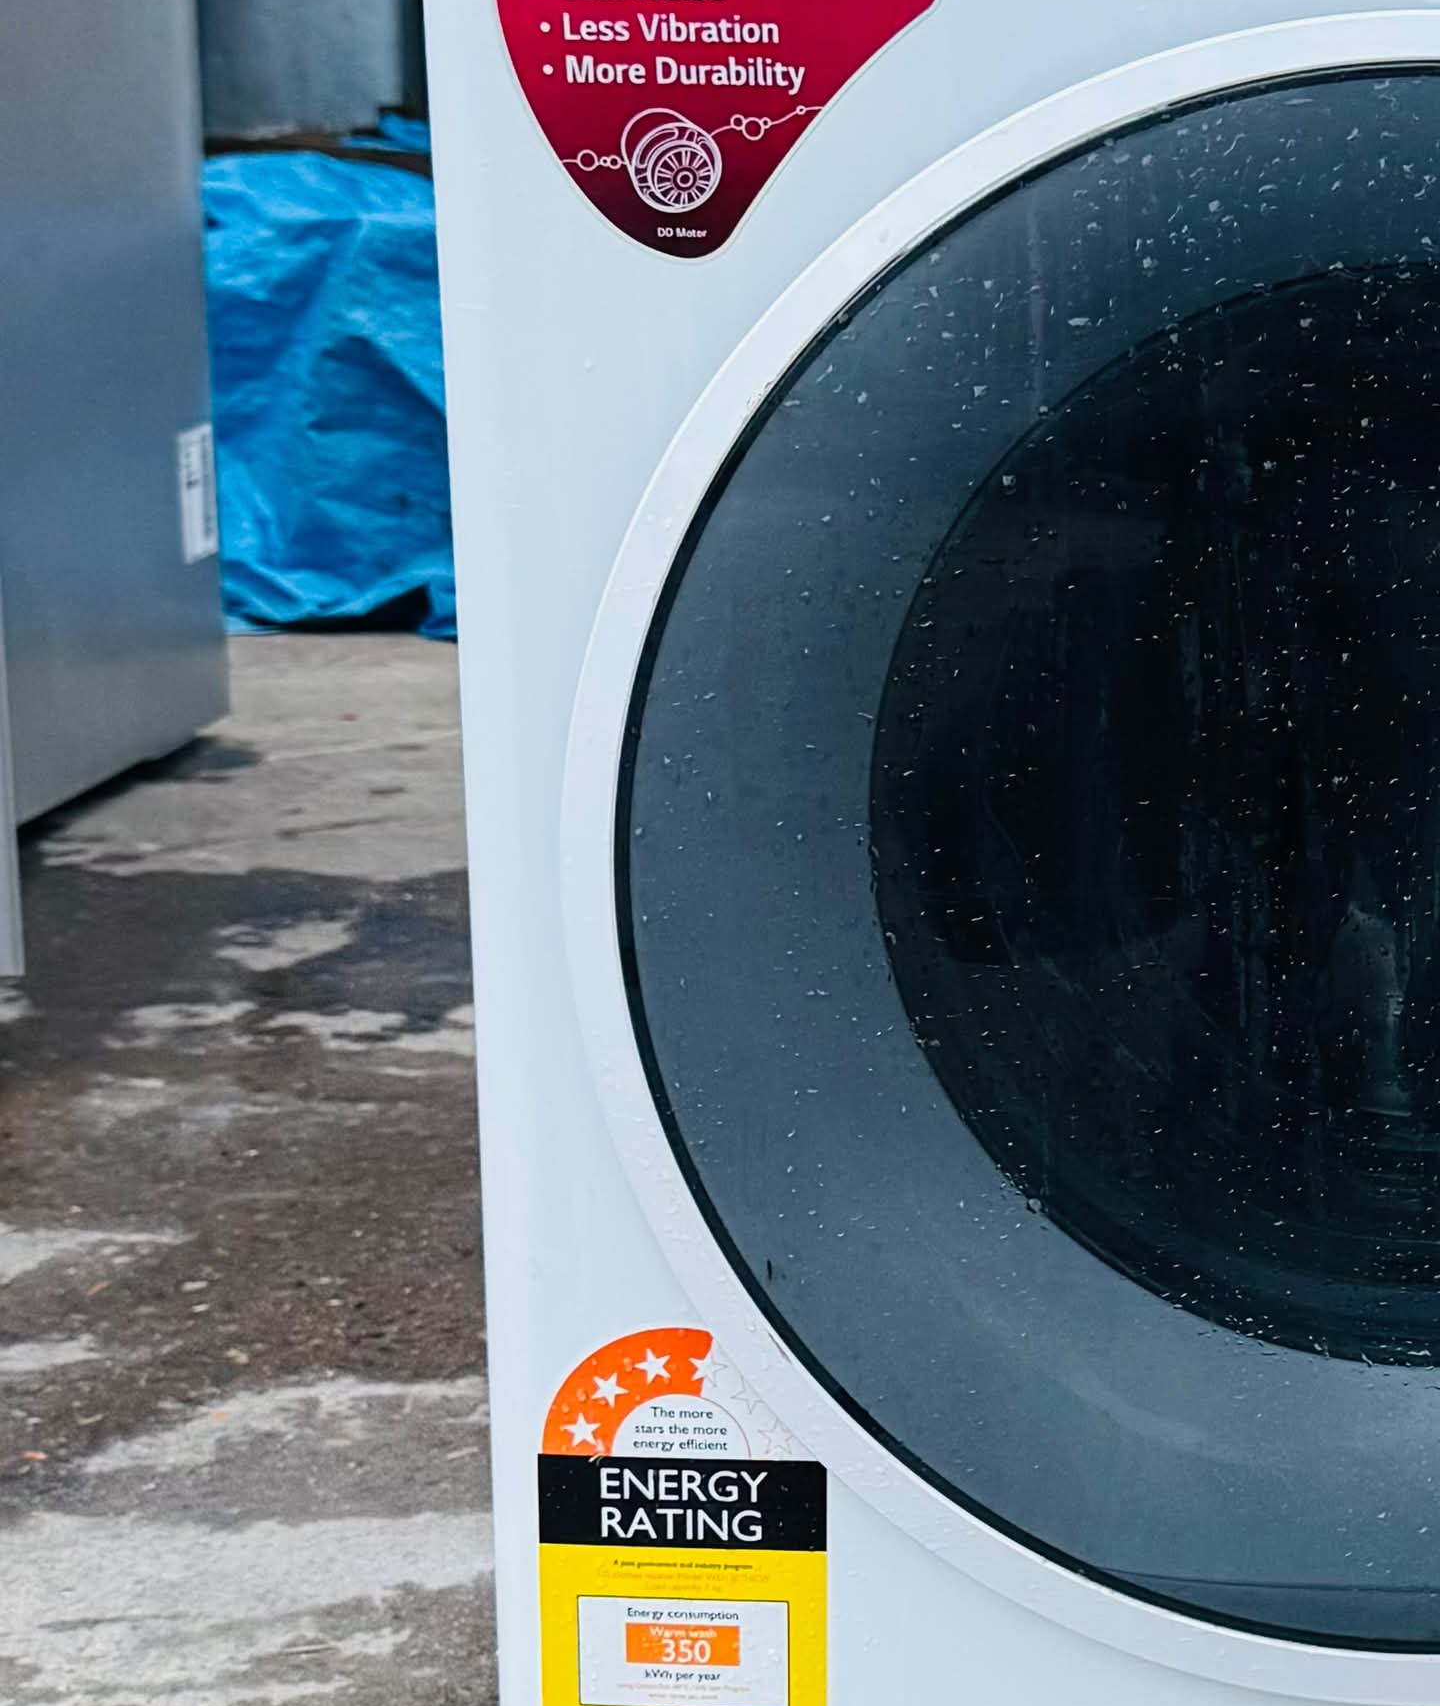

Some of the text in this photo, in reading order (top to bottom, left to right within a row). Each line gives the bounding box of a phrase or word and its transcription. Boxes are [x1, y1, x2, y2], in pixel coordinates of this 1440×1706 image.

[562, 13, 780, 44] Less Vibration
[565, 55, 805, 95] More Durability
[657, 228, 707, 238] DD Motor
[650, 1406, 713, 1419] The more
[634, 1423, 728, 1436] stars the more
[633, 1438, 728, 1453] energy efficient
[600, 1467, 768, 1503] ENERGY
[601, 1507, 763, 1542] RATING
[627, 1608, 739, 1621] Energy consumption
[650, 1626, 717, 1638] Warm wash
[661, 1640, 711, 1663] 350
[645, 1669, 721, 1682] kWh per year
